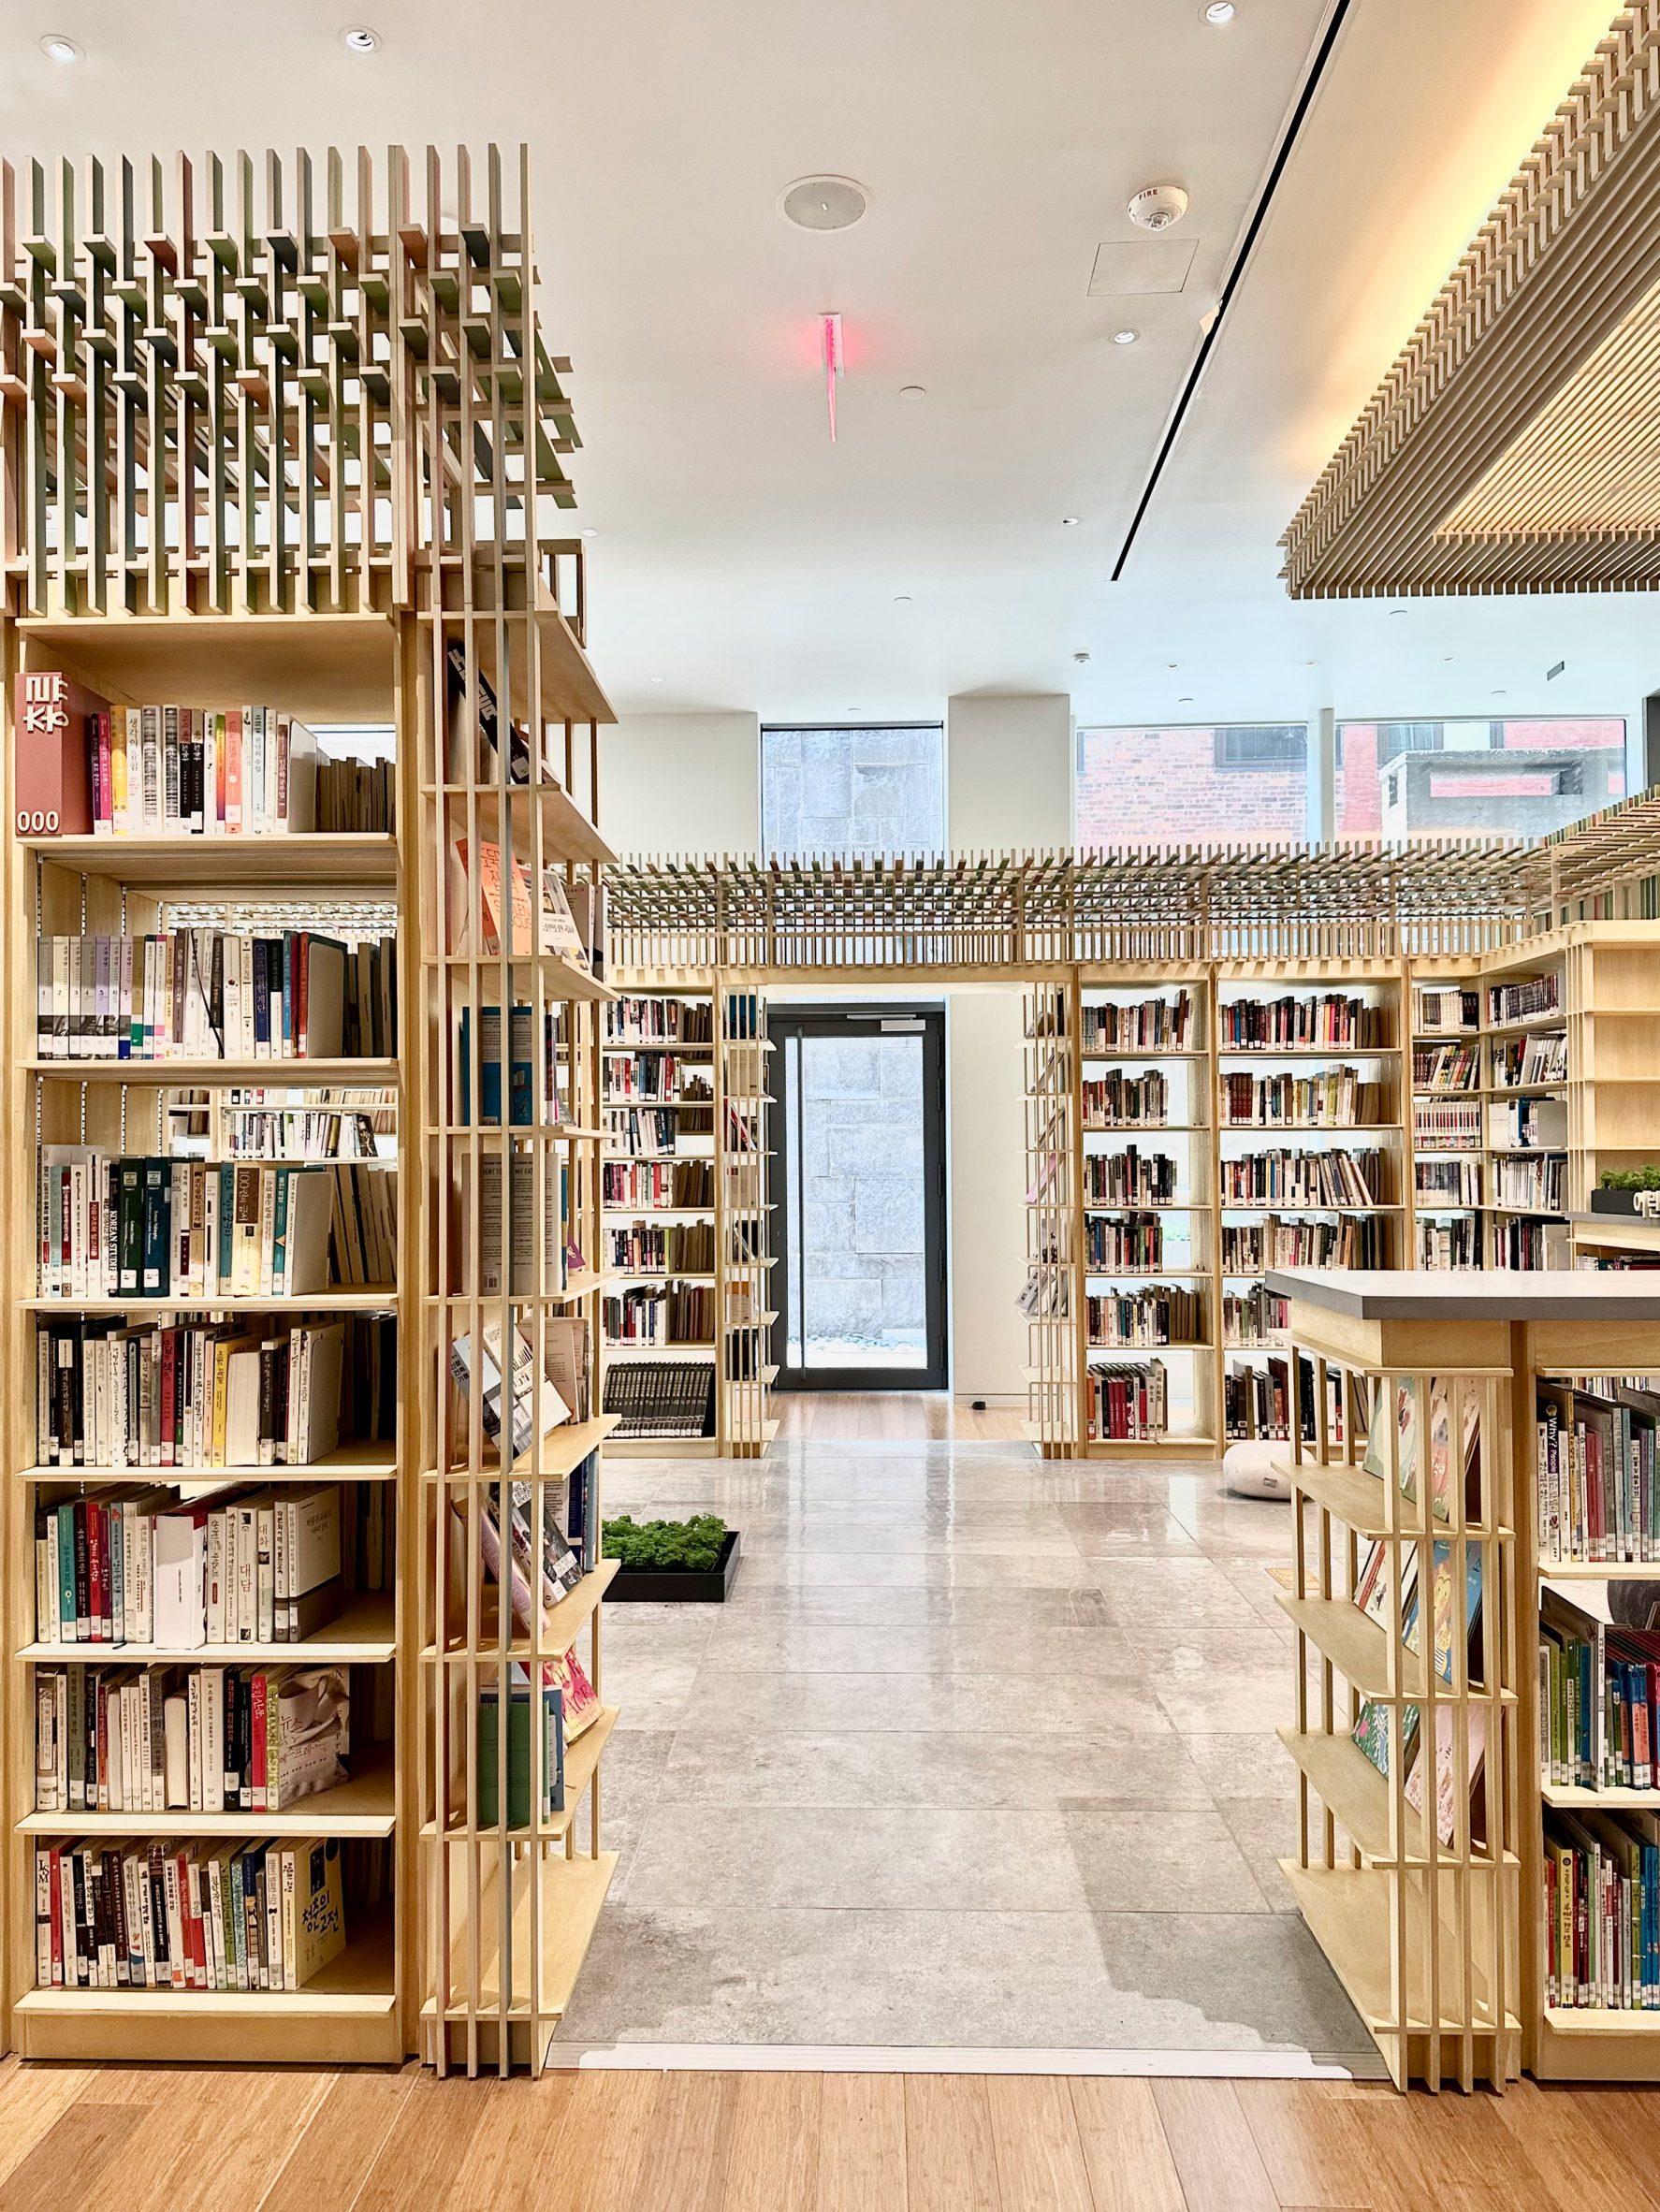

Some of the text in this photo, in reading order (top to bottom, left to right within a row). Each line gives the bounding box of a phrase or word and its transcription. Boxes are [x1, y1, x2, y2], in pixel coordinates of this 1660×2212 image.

[1137, 186, 1159, 202] FIRE
[22, 676, 69, 733] 총류
[17, 810, 60, 832] 000
[239, 1171, 250, 1222] 100권의 금서
[265, 1181, 272, 1192] 소설
[264, 1207, 271, 1219] 남자
[109, 1211, 118, 1272] KOREAN STUDIE
[1548, 1417, 1558, 1448] Why?
[1549, 1492, 1559, 1513] 만델라
[258, 1523, 269, 1548] 대화
[211, 1520, 220, 1579] 선샤인 지식노트
[78, 1564, 85, 1574] 역사
[240, 1564, 252, 1593] 대담
[126, 1864, 136, 1909] 철학의 위안
[283, 1862, 293, 1893] 청춘의 고전
[223, 1899, 231, 1918] 철학에
[269, 1893, 276, 1905] 시간
[302, 1889, 340, 1933] 청춘의 고전
[225, 1919, 233, 1936] 빠진
[227, 1937, 234, 1945] 날
